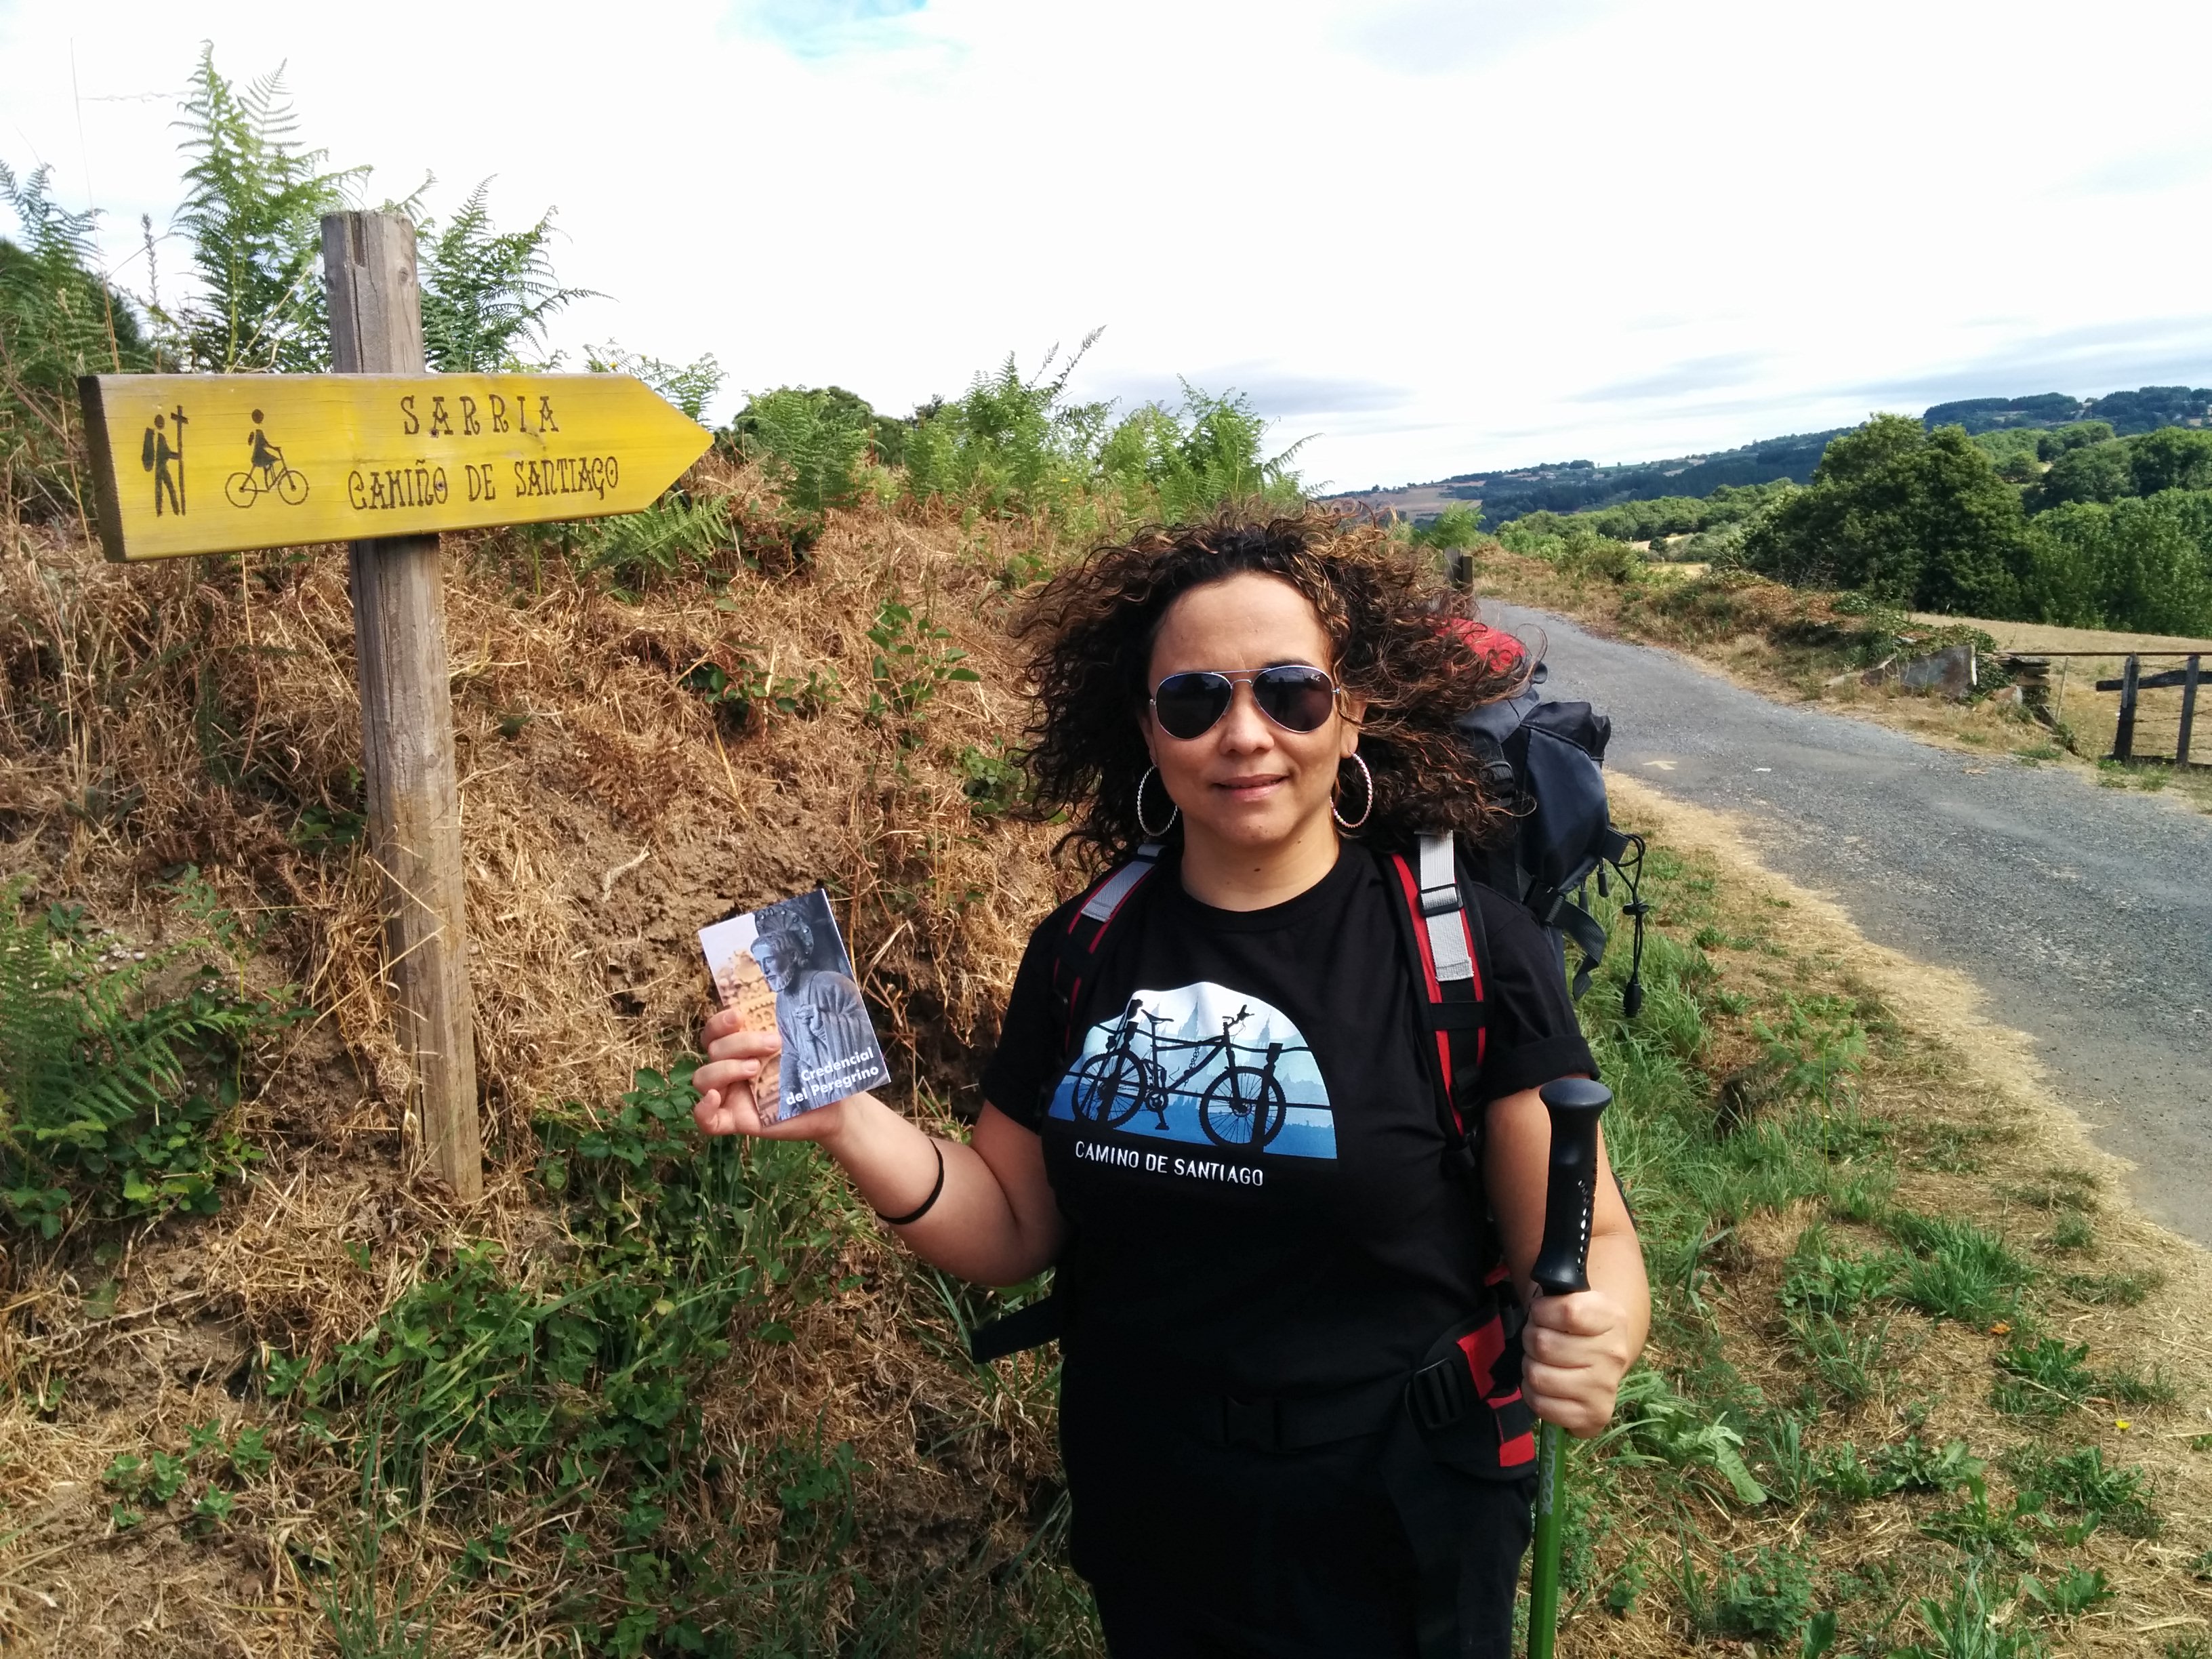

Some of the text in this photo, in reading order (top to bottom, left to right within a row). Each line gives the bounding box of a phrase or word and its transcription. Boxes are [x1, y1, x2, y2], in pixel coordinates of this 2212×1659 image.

[401, 394, 559, 436] SARRIA
[348, 456, 618, 510] CAMIÑO DE SANTIAGO
[800, 1046, 874, 1081] Credencial
[786, 1066, 879, 1105] del Peregrino
[1075, 1141, 1263, 1187] CAMINO DE SANTIAGO
